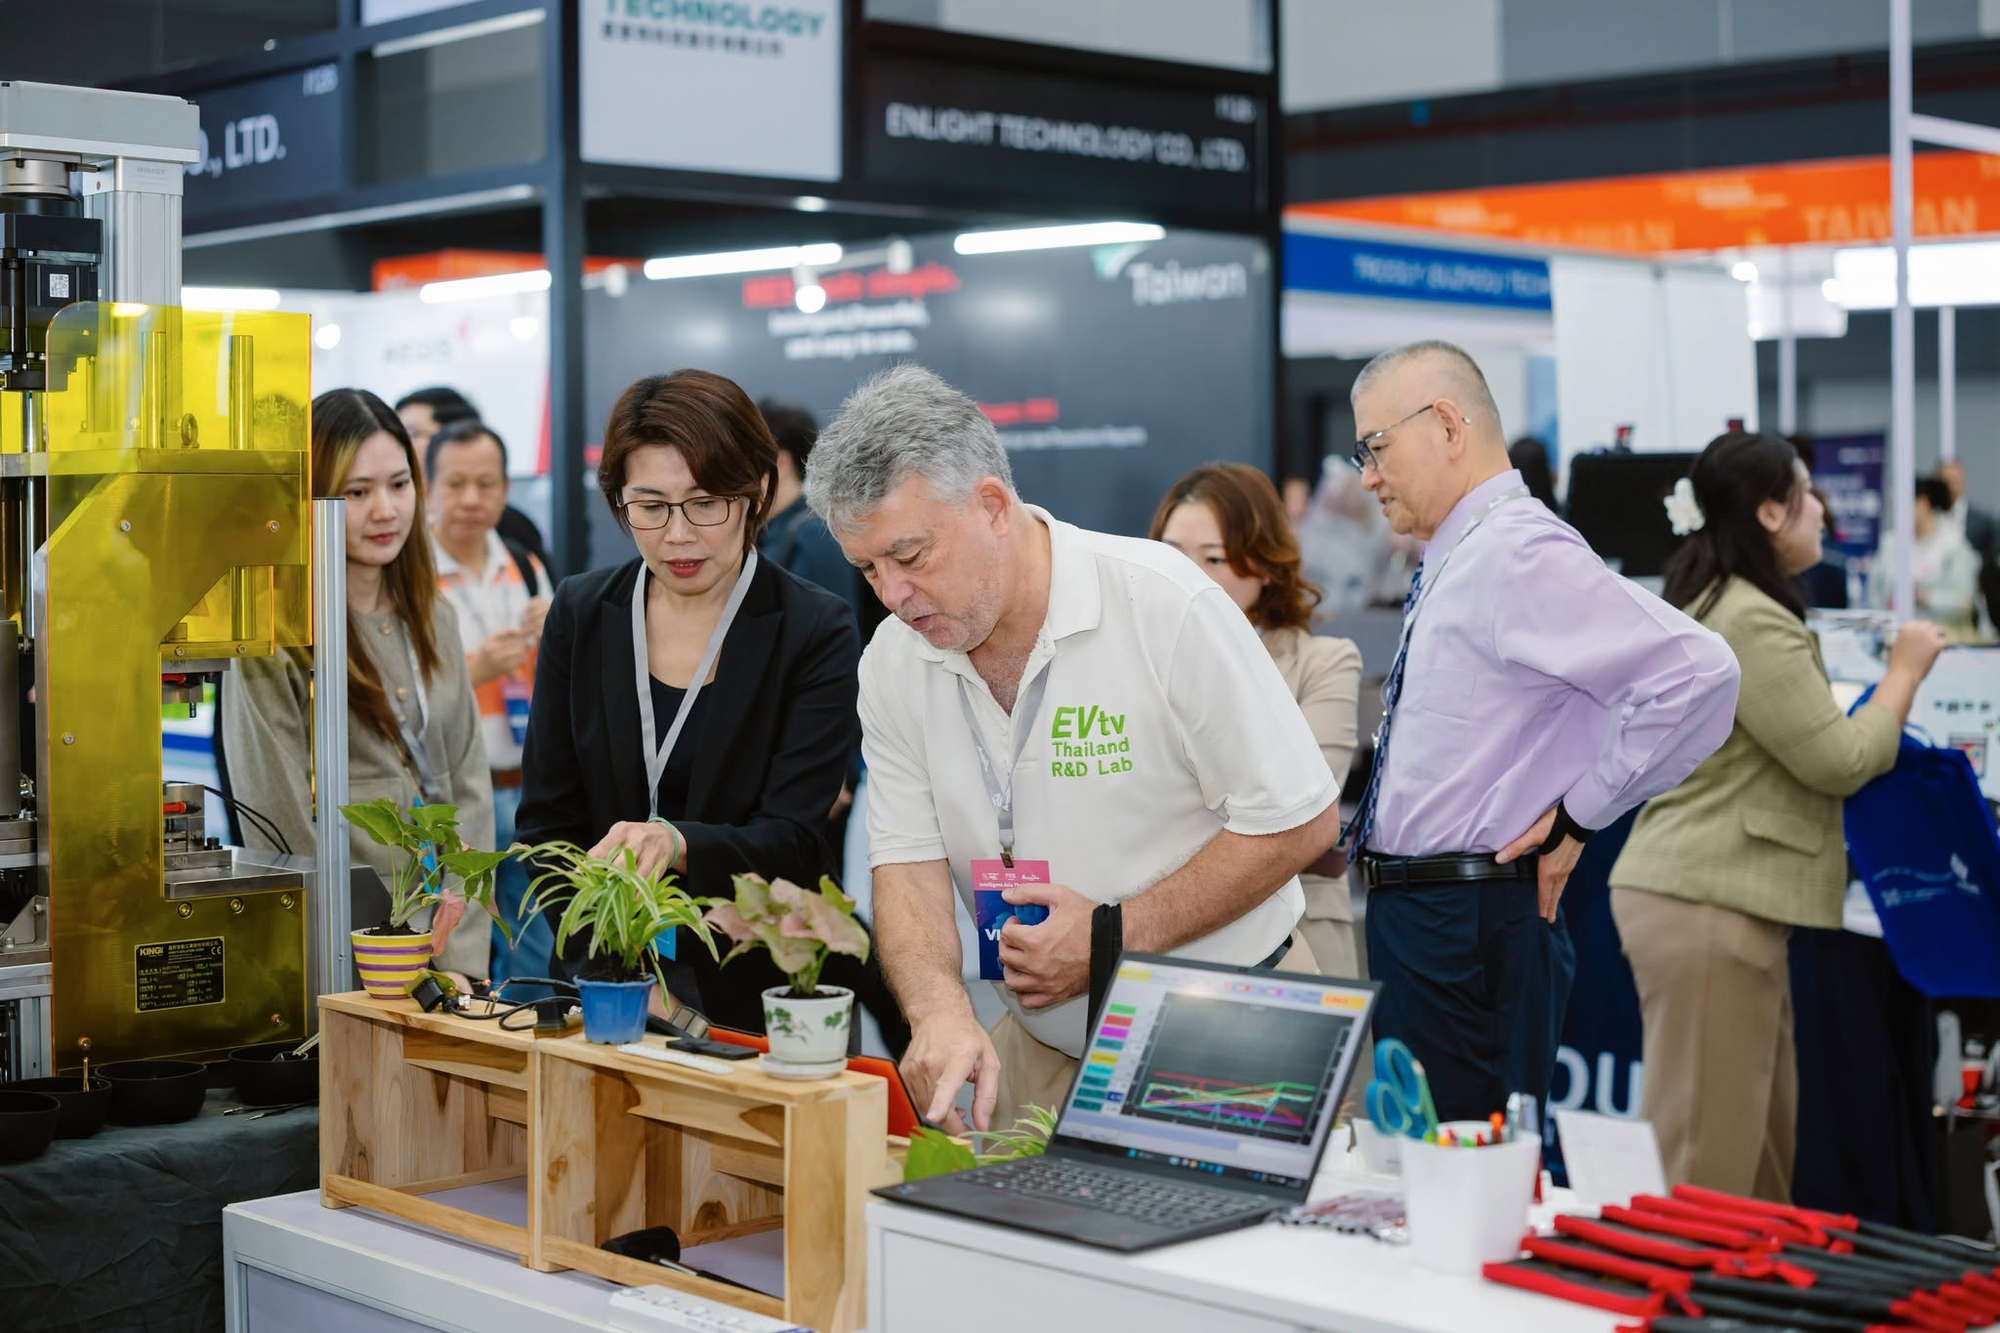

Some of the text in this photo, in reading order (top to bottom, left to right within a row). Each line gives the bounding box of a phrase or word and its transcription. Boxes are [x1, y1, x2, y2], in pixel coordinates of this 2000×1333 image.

[225, 114, 287, 170] LTD.
[885, 102, 994, 145] ENLIGHT
[999, 112, 1154, 163] TECHNOLOGY
[1126, 258, 1247, 306] Taiwan
[1051, 705, 1125, 739] EVtv
[1052, 737, 1130, 757] Thailand
[1052, 757, 1133, 777] R&D Lab
